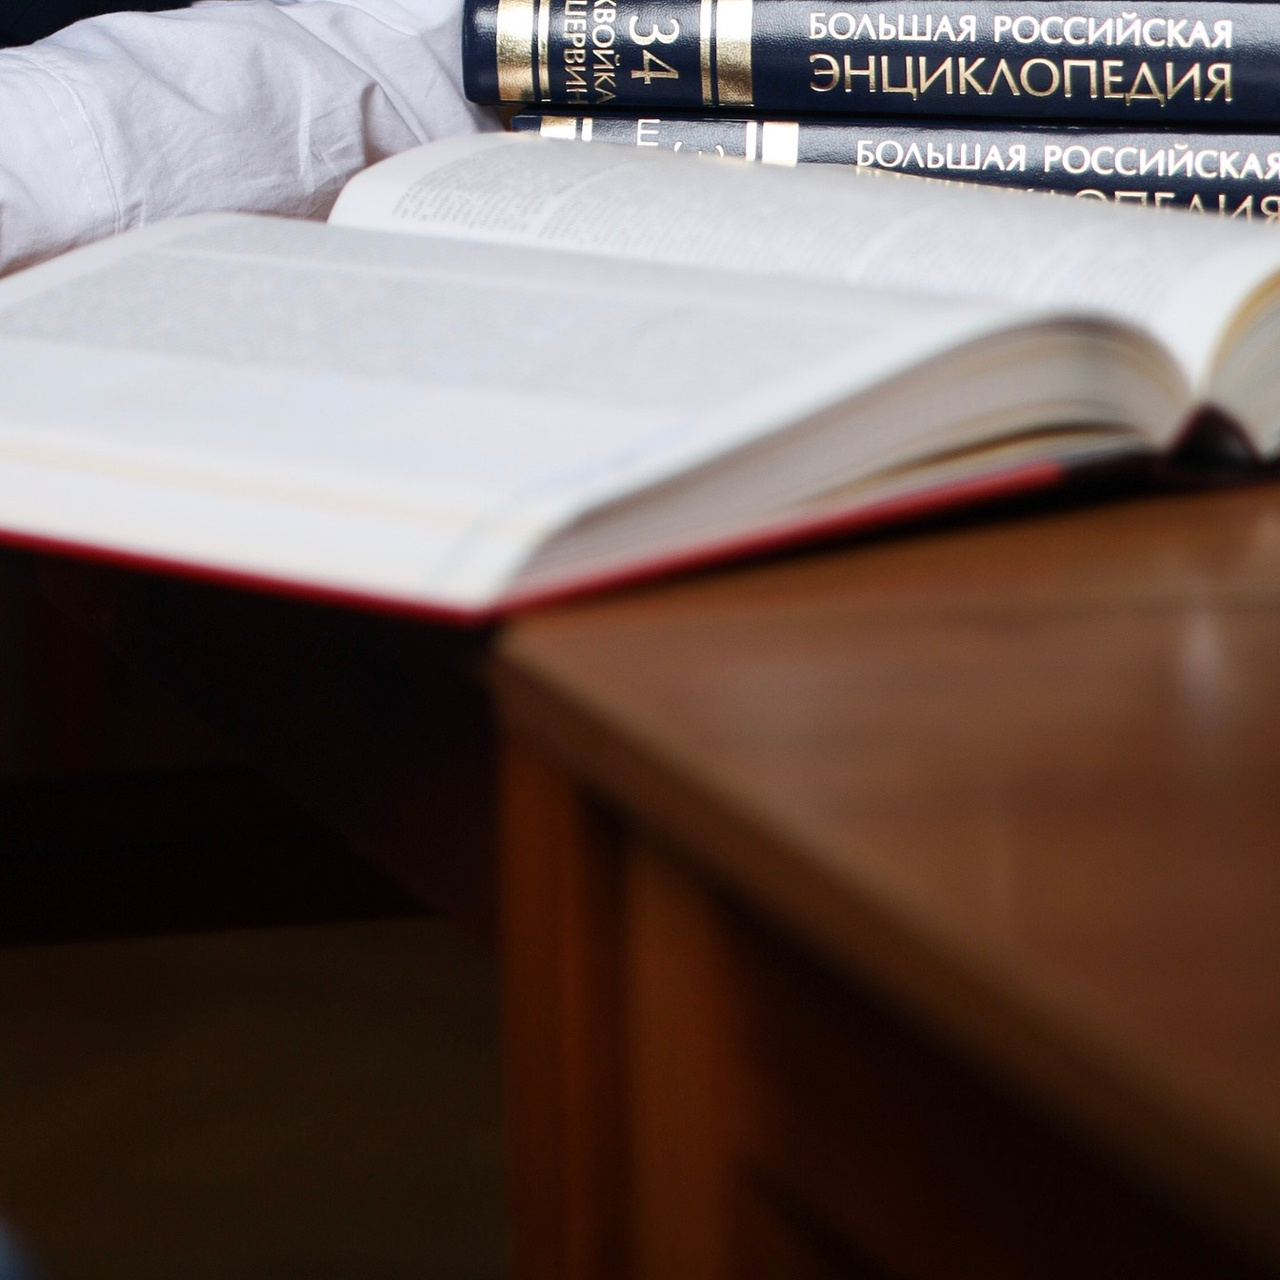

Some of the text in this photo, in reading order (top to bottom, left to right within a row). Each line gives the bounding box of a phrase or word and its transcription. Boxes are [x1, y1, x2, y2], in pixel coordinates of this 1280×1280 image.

[629, 15, 680, 85] 34
[809, 11, 1233, 49] БОЛЬШАЯ РОССИЙСКАЯ
[809, 53, 1233, 107] ЭНЦИКЛОПЕДИЯ
[856, 140, 1280, 180] БОЛЬШАЯ РОССИЙСКАЯ
